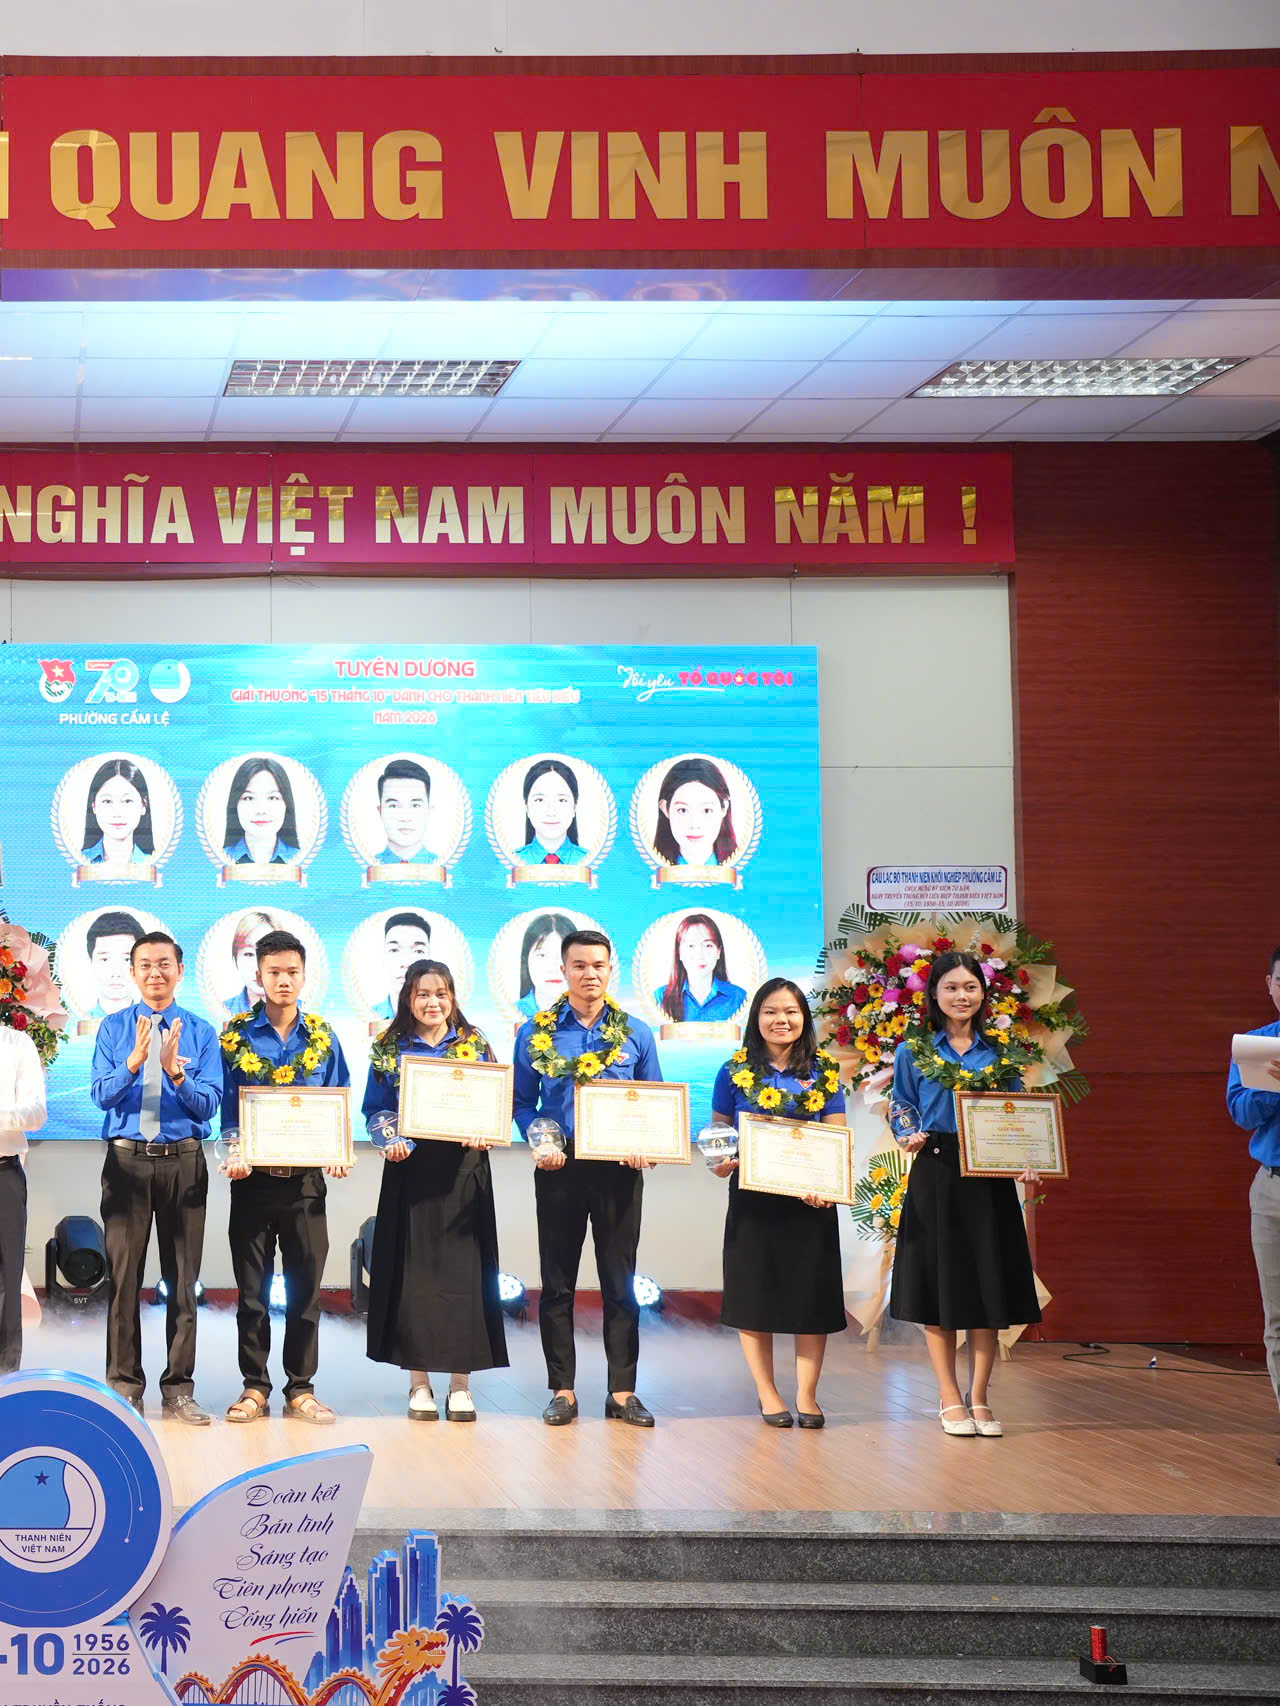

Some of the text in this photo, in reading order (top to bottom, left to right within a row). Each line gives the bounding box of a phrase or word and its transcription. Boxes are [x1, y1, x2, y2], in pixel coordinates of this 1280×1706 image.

[50, 129, 443, 230] QUANG
[494, 131, 768, 219] VINH
[826, 107, 1183, 219] MUÔN
[213, 472, 354, 556] VIỆT
[375, 486, 525, 544] NAM
[550, 472, 745, 545] MUÔN
[775, 473, 925, 544] NĂM
[961, 486, 977, 545] !
[335, 657, 475, 677] TUYÊN DƯƠNG
[679, 665, 702, 686] TỔ
[706, 667, 758, 686] QUỐC
[762, 669, 793, 686] TÔI
[59, 708, 118, 725] PHƯỜNG
[154, 709, 170, 727] LỆ
[405, 711, 437, 724] 2026
[902, 871, 918, 883] THANH
[246, 1482, 341, 1507] Đoàn kết
[297, 1512, 334, 1535] lĩnh
[50, 1533, 71, 1541] NIÊN
[22, 1544, 42, 1554] VIỆT
[236, 1543, 329, 1571] Sáng tạo
[213, 1575, 325, 1600] Tiên phong
[220, 1605, 318, 1631] Cống hiến
[73, 1633, 130, 1651] 1956
[72, 1658, 130, 1675] 2026
